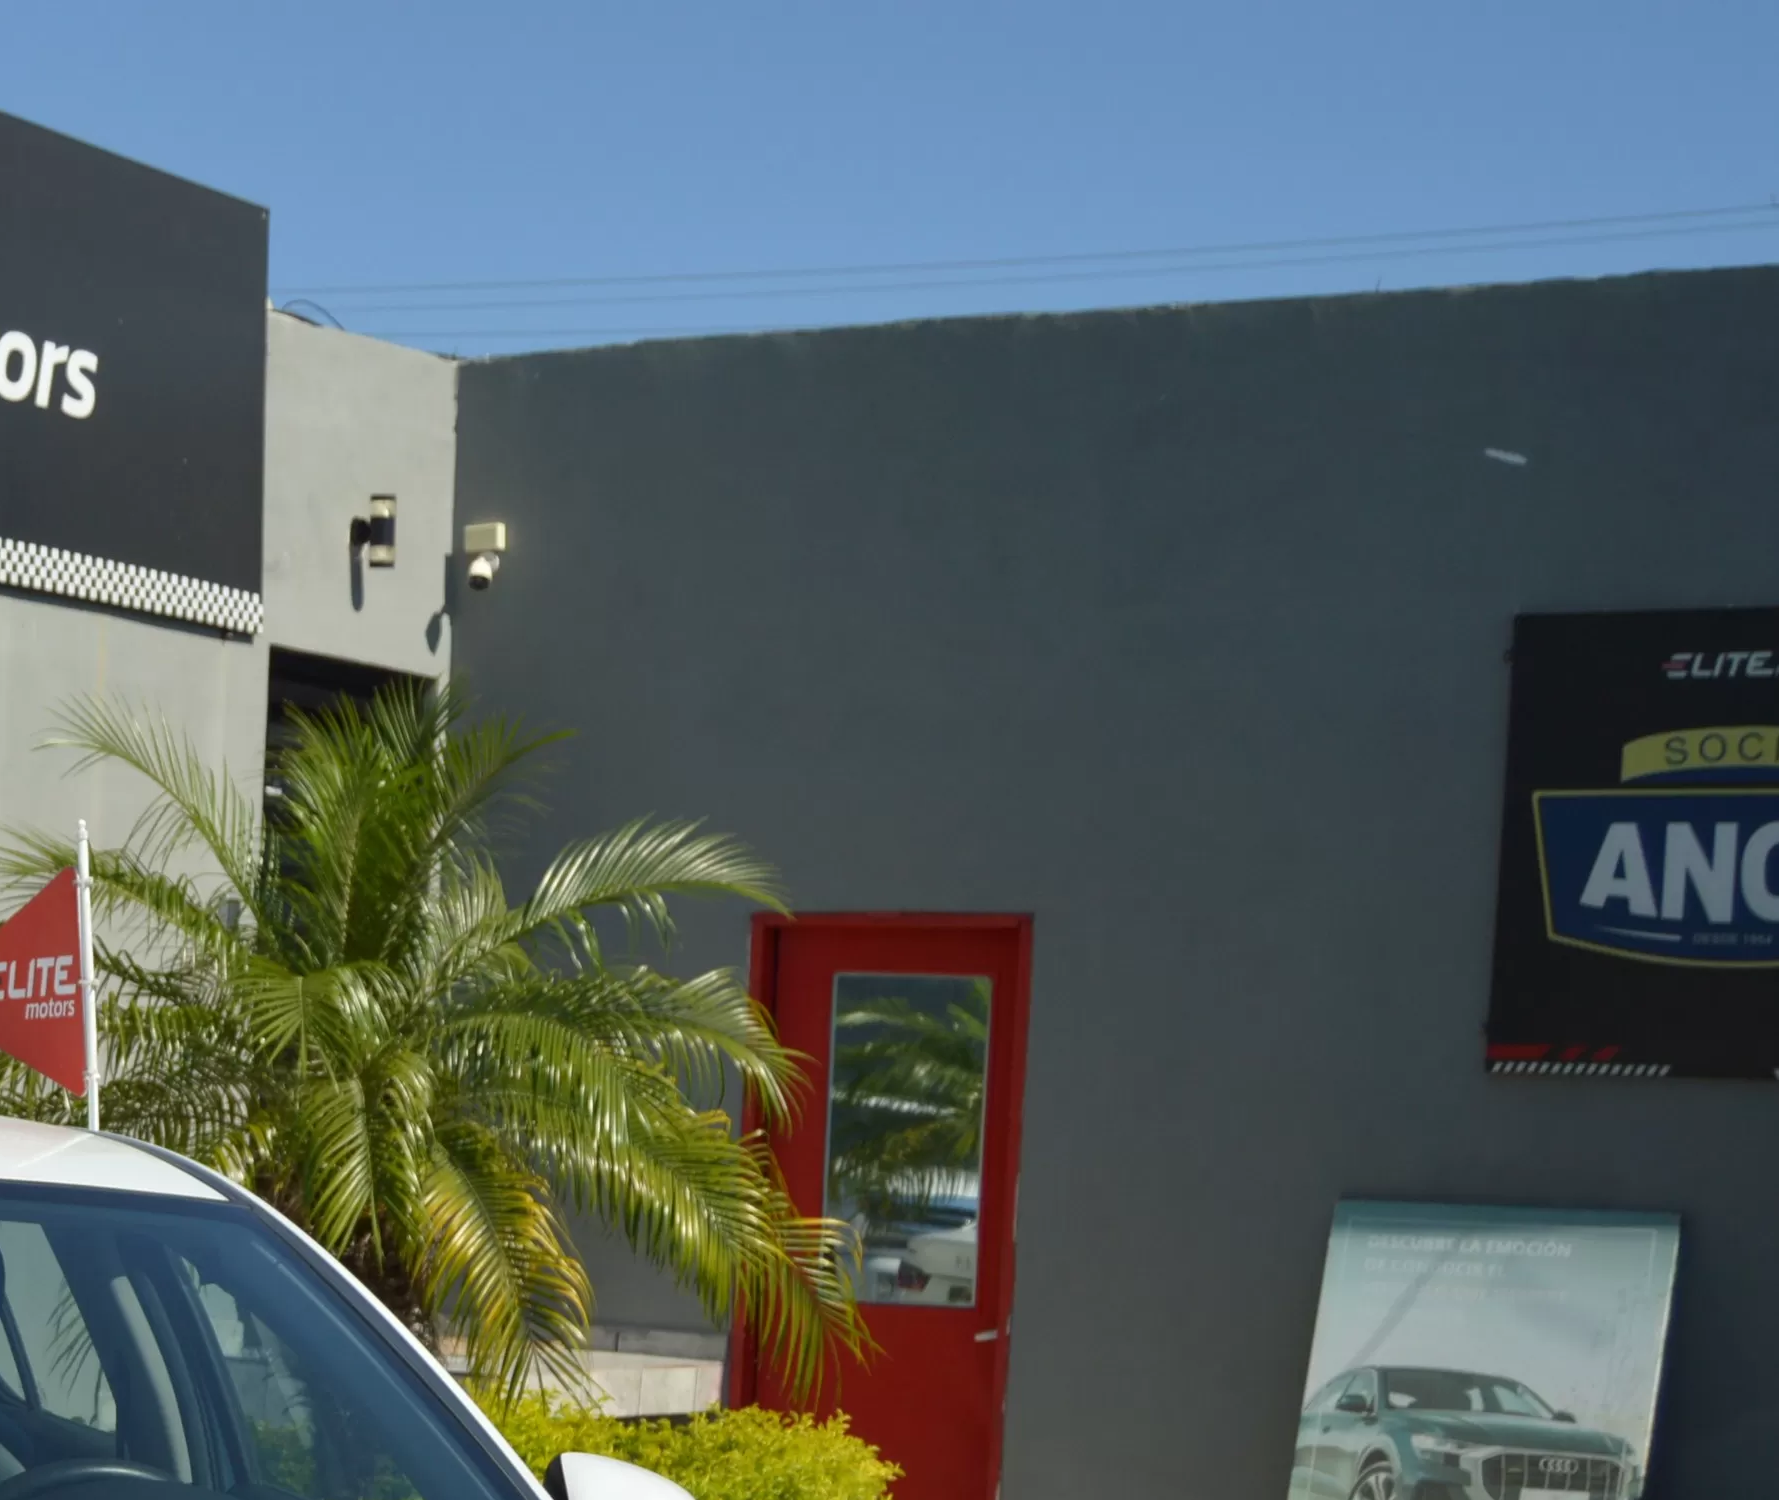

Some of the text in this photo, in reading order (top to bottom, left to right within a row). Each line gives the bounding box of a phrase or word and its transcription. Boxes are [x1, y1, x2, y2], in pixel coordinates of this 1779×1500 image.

[1662, 651, 1775, 679] ELITE
[25, 998, 75, 1020] motors
[1459, 1237, 1482, 1254] LA
[1485, 1237, 1573, 1258] EMOCIÓN
